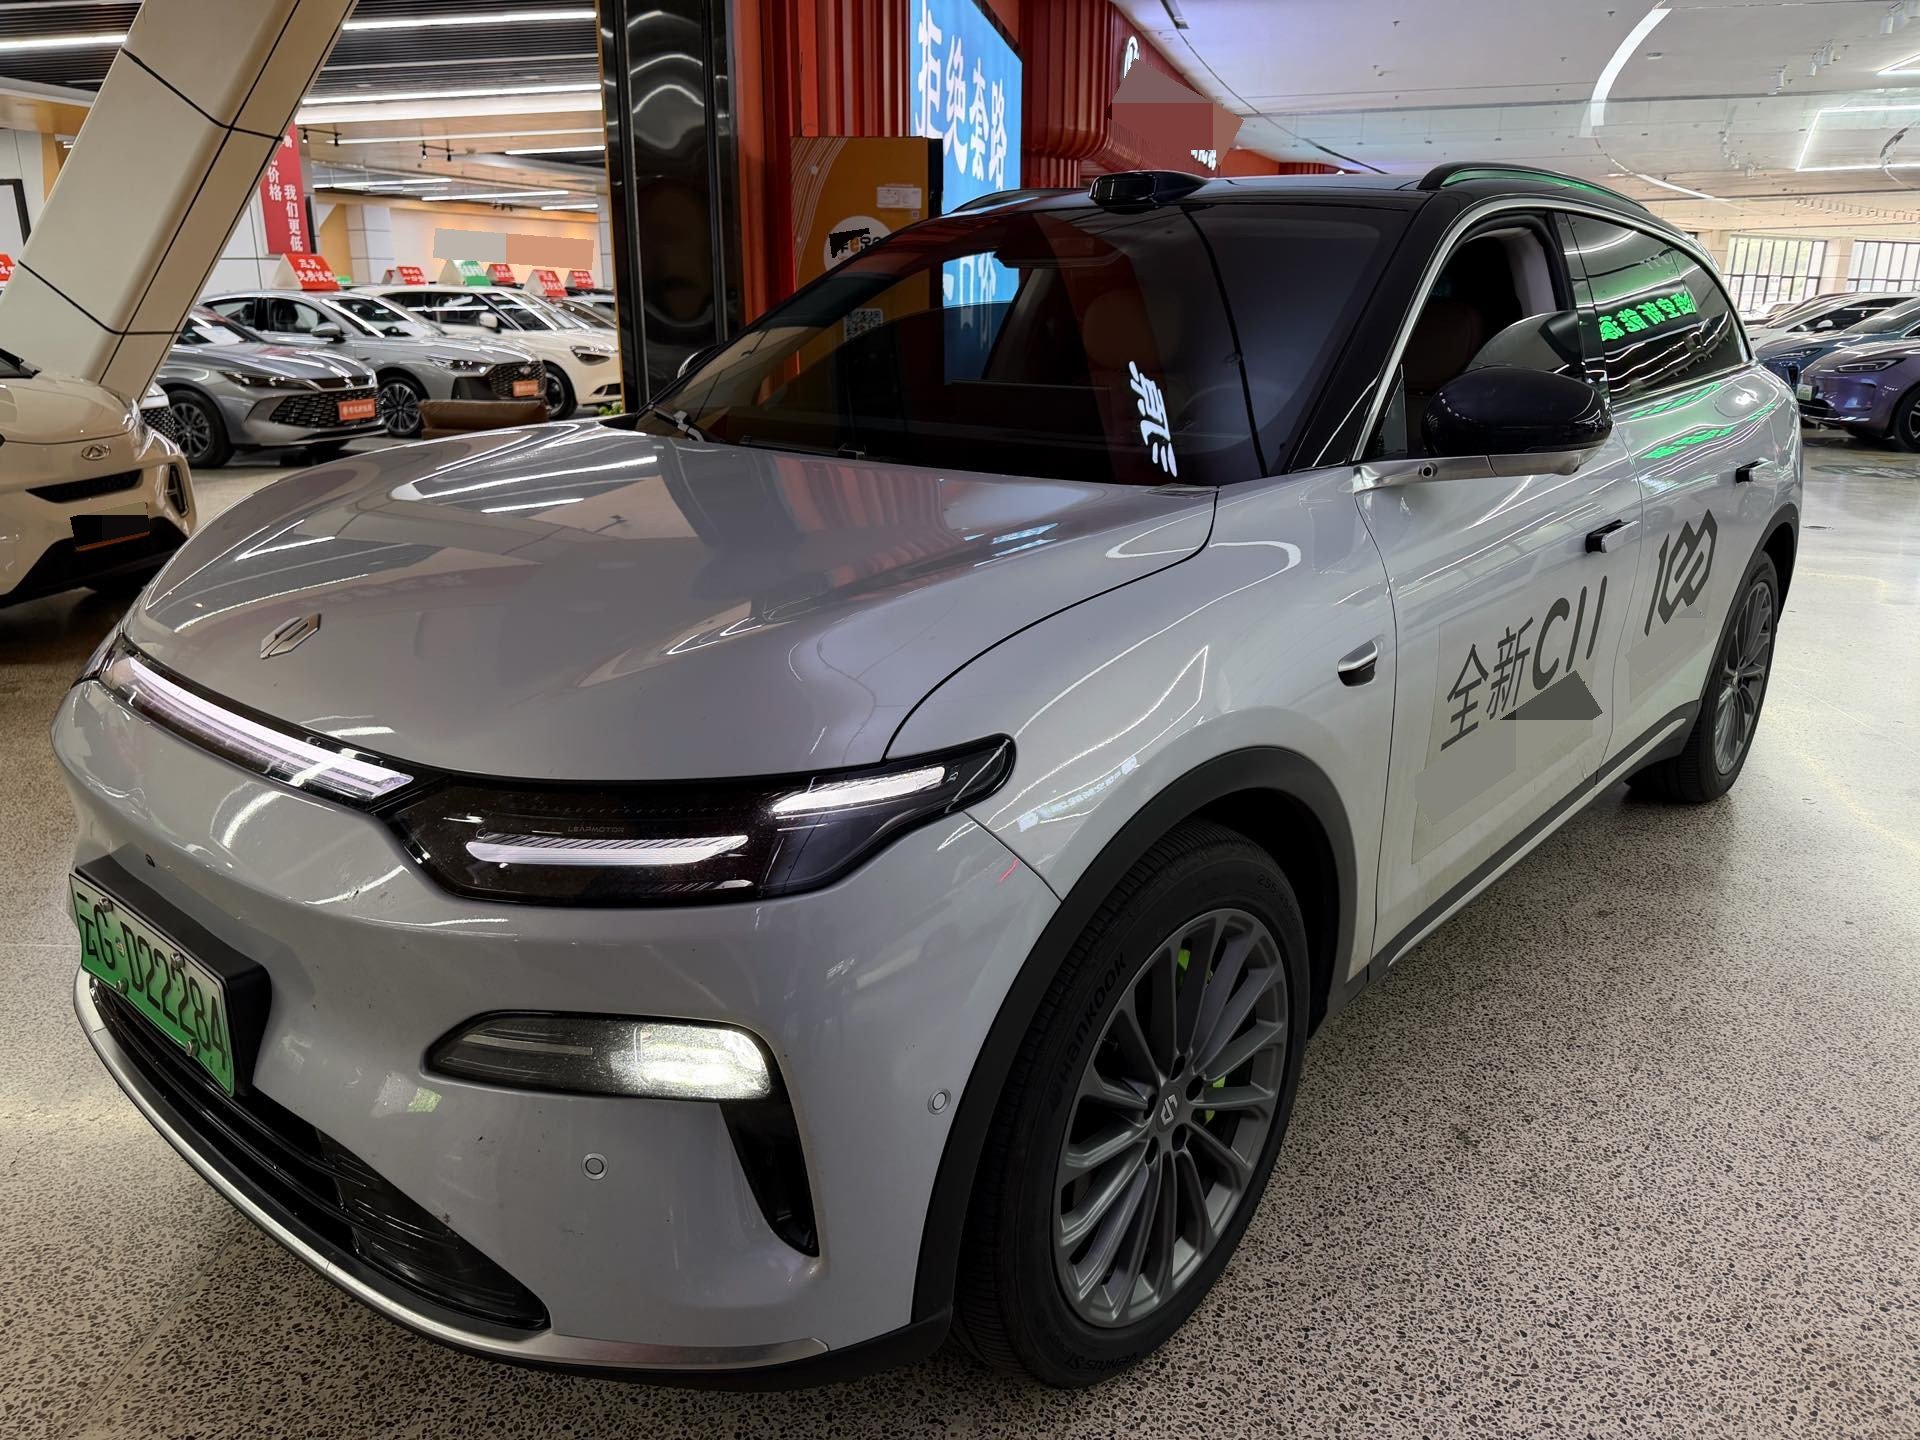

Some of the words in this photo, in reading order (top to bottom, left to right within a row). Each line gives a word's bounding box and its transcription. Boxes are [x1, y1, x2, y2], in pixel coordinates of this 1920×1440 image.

[915, 0, 1008, 190] 拒绝套路
[284, 184, 304, 252] 我们更低
[567, 825, 625, 834] LEAPMOTOR
